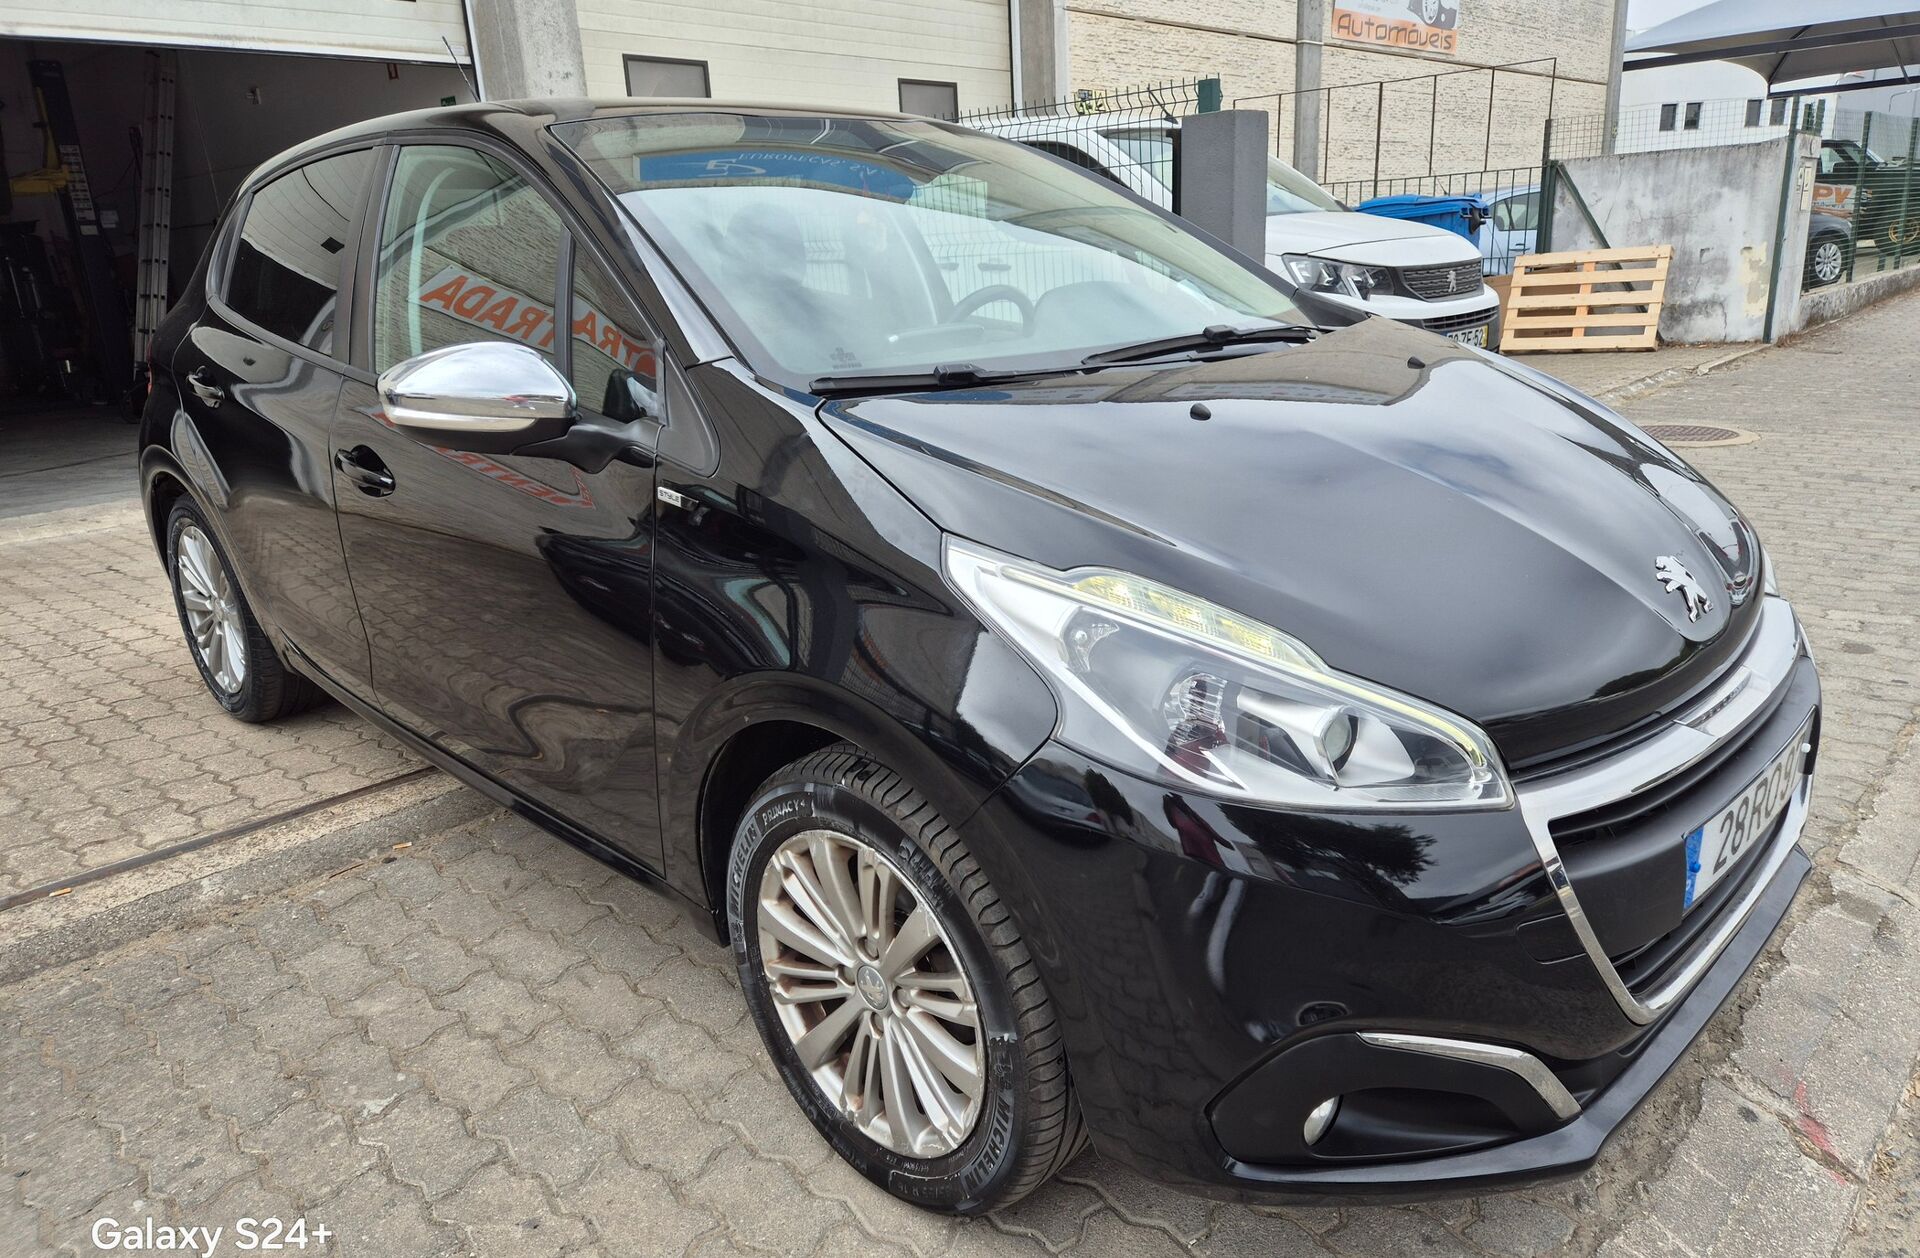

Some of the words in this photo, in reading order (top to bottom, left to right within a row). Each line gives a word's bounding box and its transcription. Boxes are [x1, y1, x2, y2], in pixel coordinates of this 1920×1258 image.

[762, 799, 799, 826] PRIMACY
[729, 823, 758, 917] MICHELIN
[964, 1095, 1011, 1191] MICHELIN
